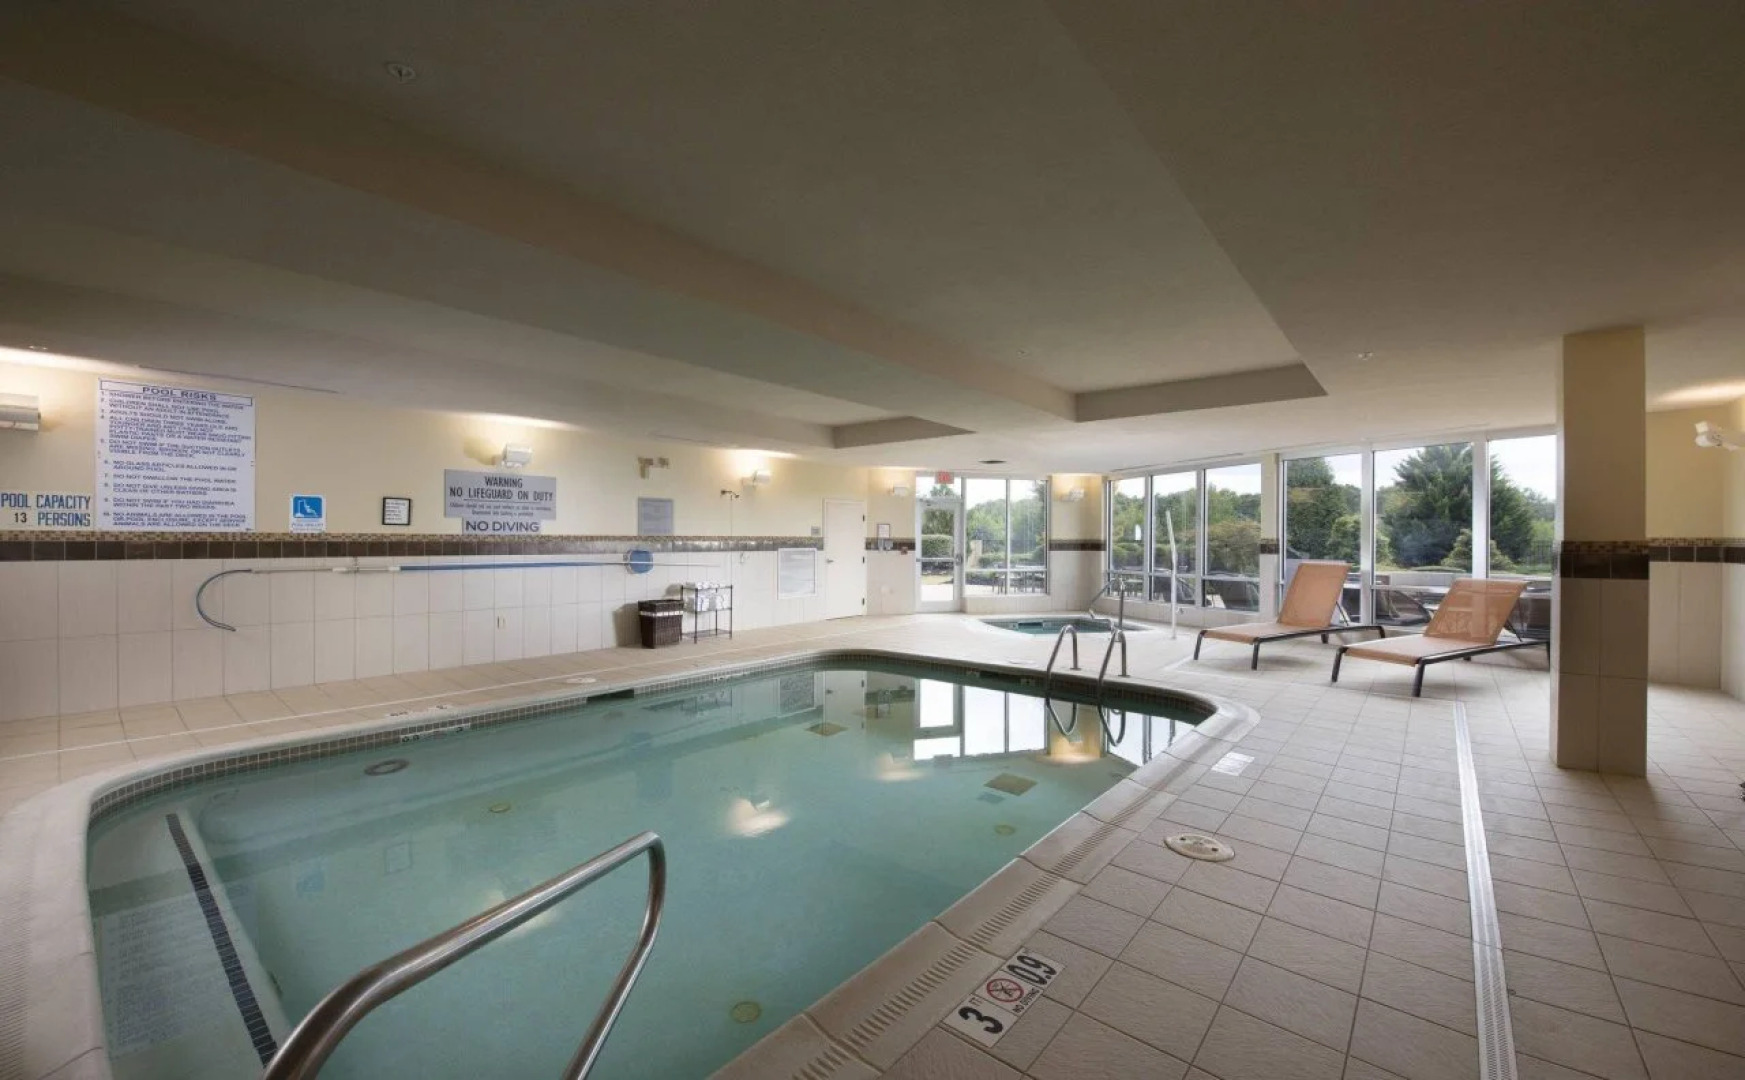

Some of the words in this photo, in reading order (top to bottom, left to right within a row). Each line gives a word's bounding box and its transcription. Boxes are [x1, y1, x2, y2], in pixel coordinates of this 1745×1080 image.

[142, 387, 177, 396] POOL
[180, 390, 217, 401] RISKS
[484, 477, 523, 488] WARNING
[449, 487, 463, 497] NO
[468, 488, 514, 500] LIFEGUARD
[517, 491, 529, 501] ON
[533, 491, 553, 501] DUTY
[1, 493, 32, 508] POOL
[36, 494, 91, 510] CAPACITY
[14, 512, 28, 523] 13
[37, 512, 91, 527] PERSONS
[465, 521, 489, 531] NO
[491, 522, 540, 532] DIVING
[957, 1005, 1004, 1035] 3
